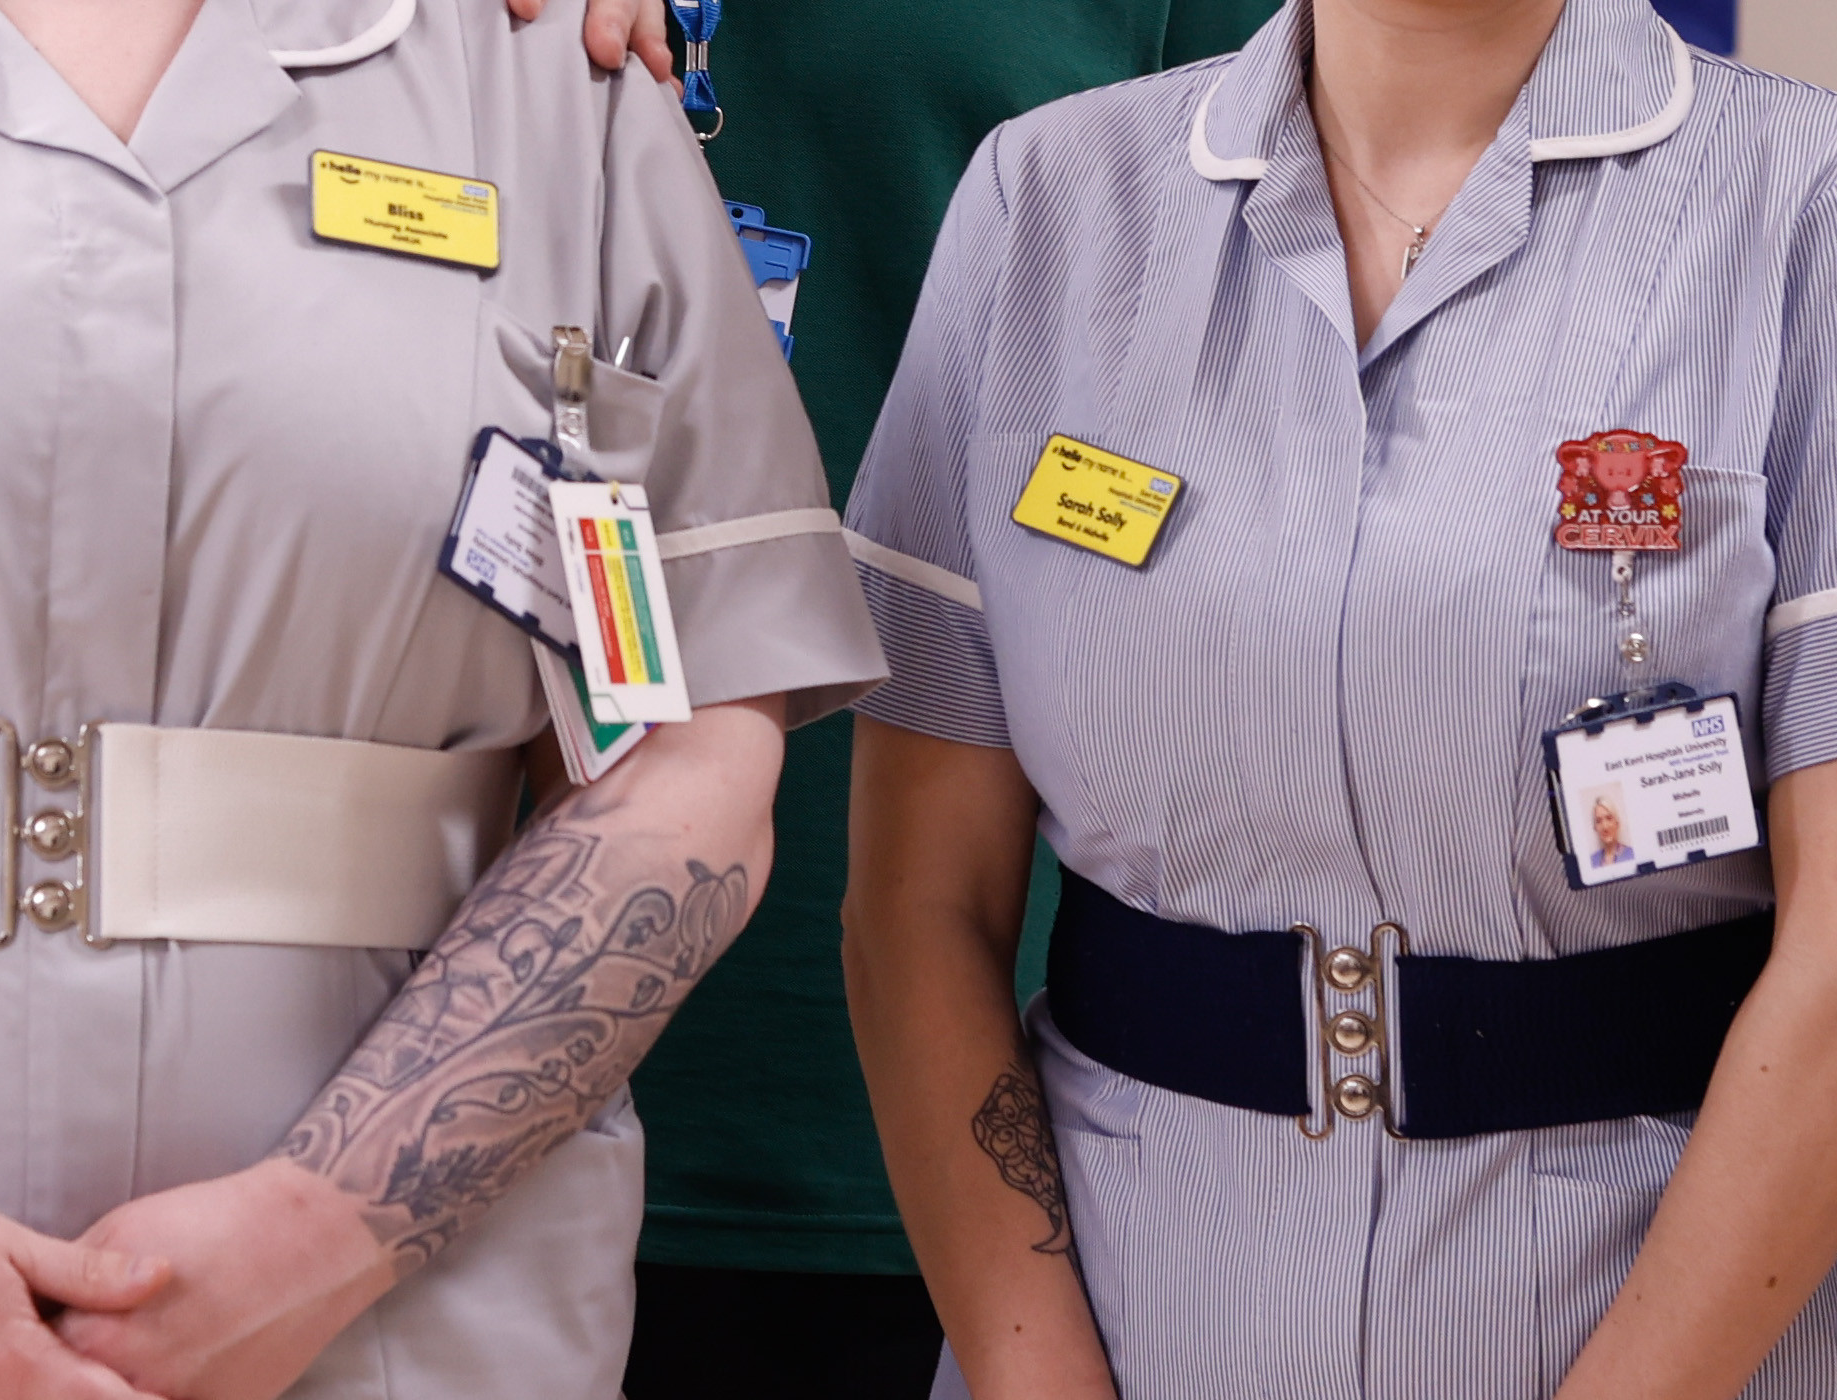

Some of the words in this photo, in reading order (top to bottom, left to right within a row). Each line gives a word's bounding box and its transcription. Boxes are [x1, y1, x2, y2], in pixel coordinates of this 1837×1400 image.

[388, 202, 424, 221] Bliss
[1057, 492, 1094, 517] Sarah
[1577, 509, 1603, 523] AT
[1605, 509, 1660, 524] YOUR
[1556, 523, 1680, 550] CERVIX
[1693, 716, 1724, 736] NHS
[1604, 760, 1624, 772] East
[1624, 755, 1645, 767] Kent
[1645, 746, 1683, 763] Hospitals
[1684, 737, 1727, 753] University
[1698, 760, 1723, 775] Solly
